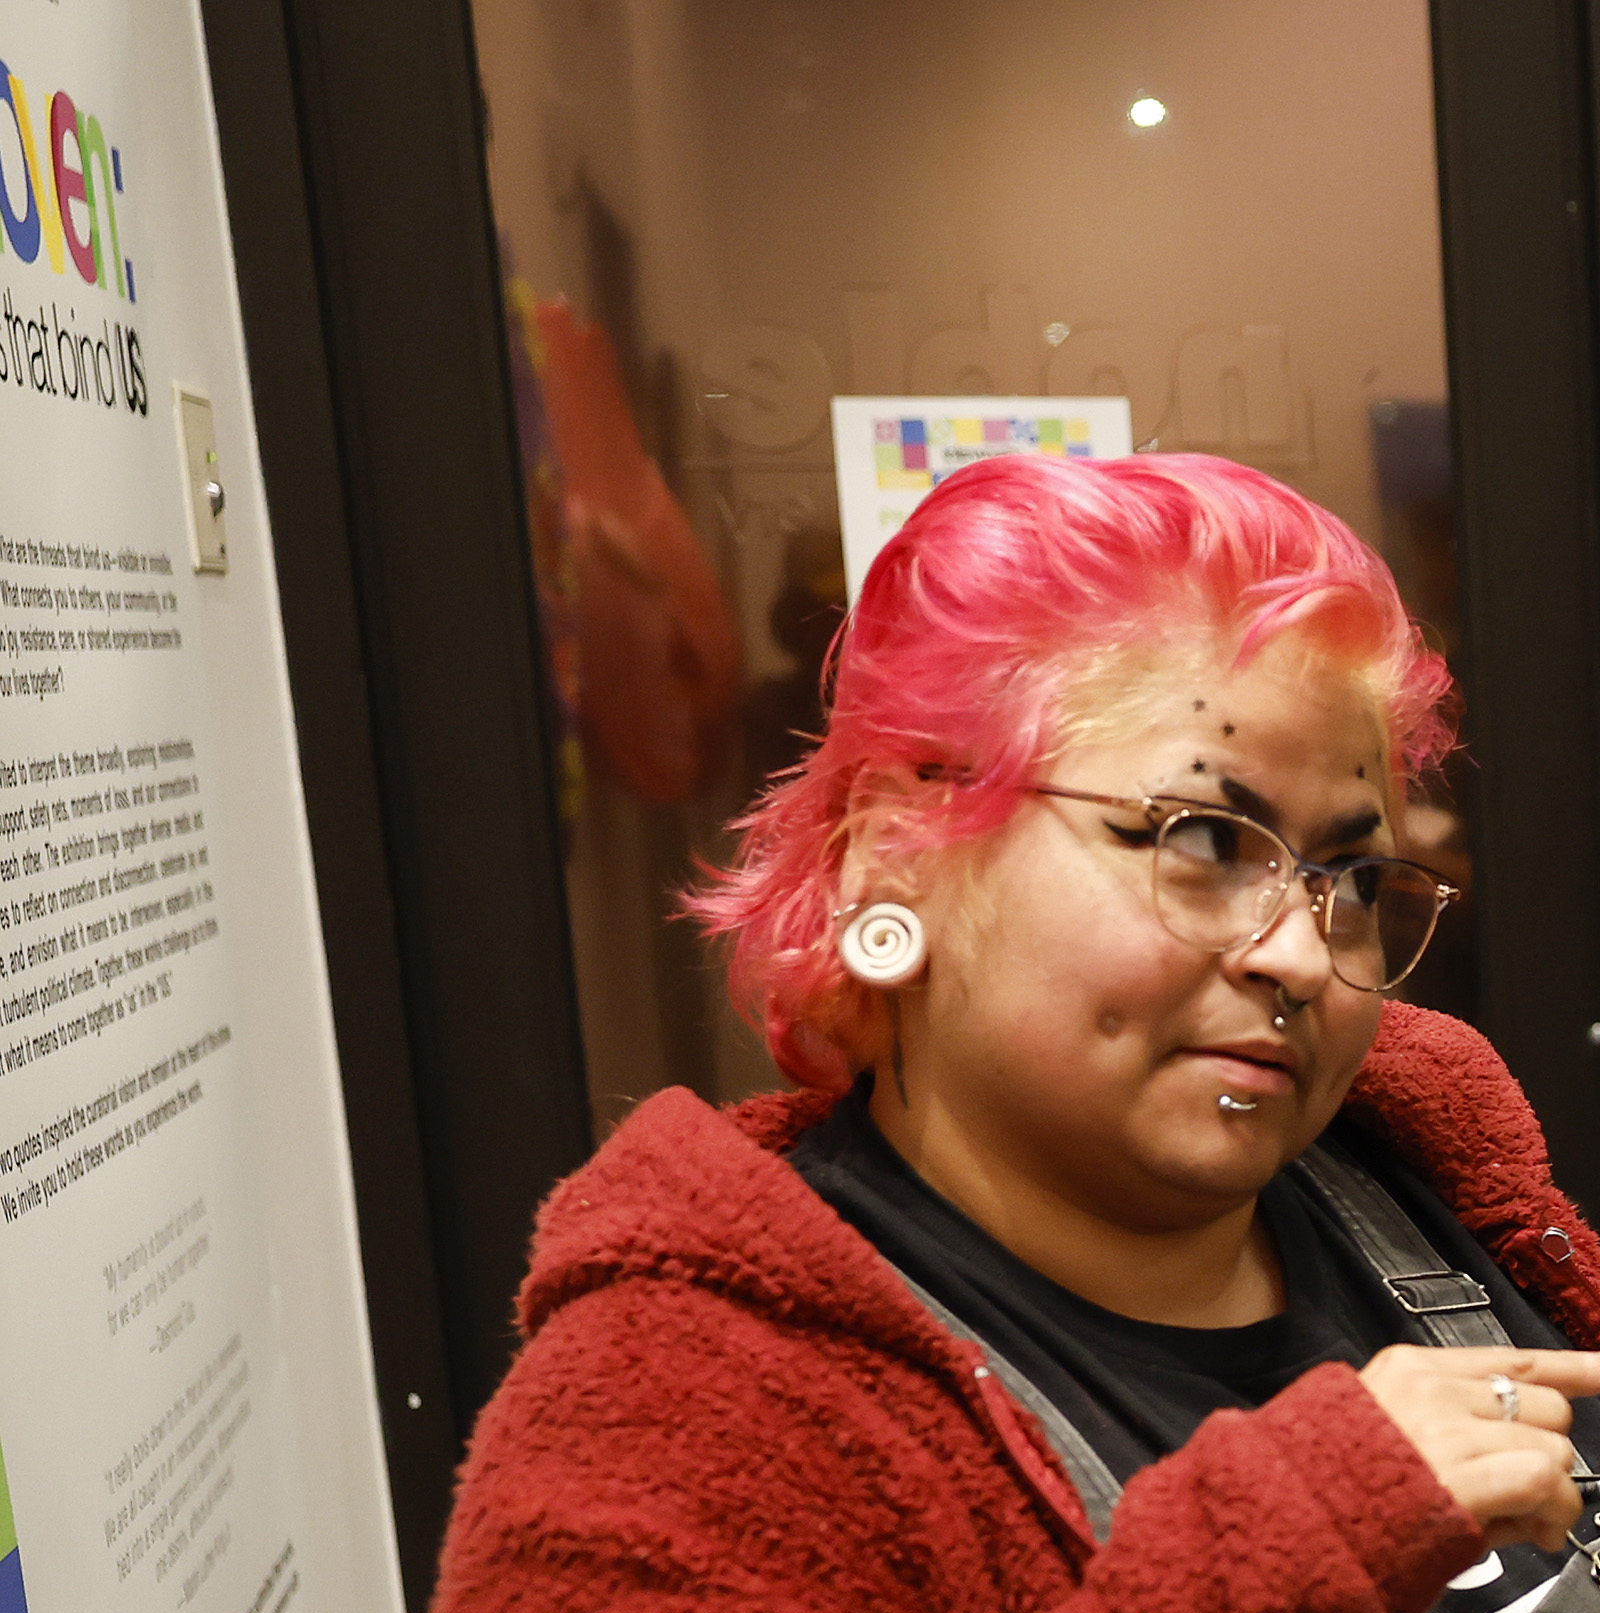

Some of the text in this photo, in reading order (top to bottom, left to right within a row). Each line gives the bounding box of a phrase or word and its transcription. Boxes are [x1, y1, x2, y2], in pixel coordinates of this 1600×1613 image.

[3, 287, 58, 396] that
[52, 301, 117, 409] bind
[14, 541, 27, 564] are
[26, 538, 40, 565] the
[38, 540, 67, 568] threads
[65, 543, 83, 569] that
[81, 544, 101, 571] bind
[19, 584, 53, 609] connects
[52, 587, 69, 615] you
[67, 586, 78, 610] to
[11, 667, 30, 695] lives
[17, 760, 27, 785] to
[26, 754, 58, 786] interpret
[57, 752, 72, 778] the
[71, 750, 96, 775] theme
[28, 799, 51, 832] safety
[0, 851, 20, 883] each
[43, 841, 60, 868] The
[60, 833, 94, 865] exhibition
[96, 831, 119, 859] brings
[10, 899, 21, 925] to
[21, 890, 47, 922] reflect
[46, 891, 58, 914] on
[58, 878, 97, 911] connection
[97, 870, 112, 898] and
[8, 942, 25, 975] and
[26, 936, 58, 968] envision
[59, 925, 79, 954] what
[85, 917, 109, 943] means
[108, 913, 118, 936] to
[1, 985, 40, 1025] turbulent
[38, 972, 69, 1016] political
[4, 1039, 26, 1073] what
[23, 1035, 33, 1062] it
[31, 1028, 59, 1059] means
[56, 1022, 67, 1046] to
[66, 1015, 88, 1043] come
[85, 1001, 115, 1037] together
[12, 1132, 43, 1173] quotes
[40, 1109, 74, 1150] inspired
[72, 1105, 86, 1132] the
[85, 1085, 118, 1126] curatorial
[0, 1191, 18, 1224] We
[15, 1179, 42, 1215] invite
[40, 1172, 58, 1207] you
[55, 1164, 67, 1190] to
[64, 1150, 84, 1183] hold
[82, 1142, 104, 1173] these
[102, 1129, 125, 1159] words
